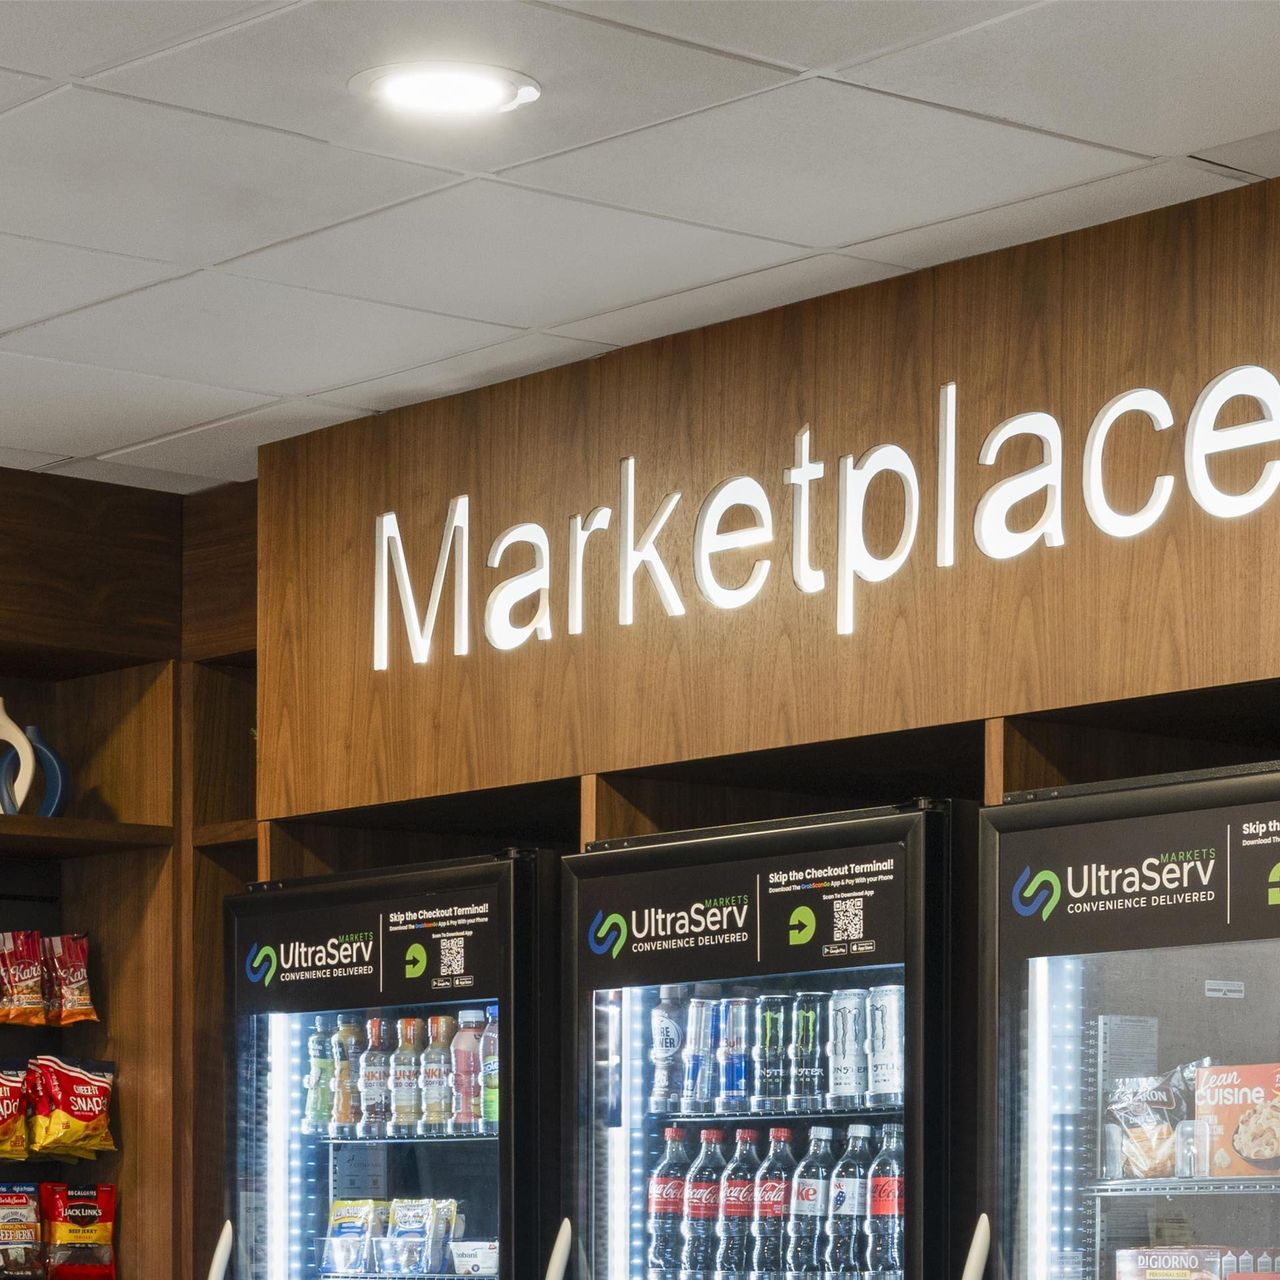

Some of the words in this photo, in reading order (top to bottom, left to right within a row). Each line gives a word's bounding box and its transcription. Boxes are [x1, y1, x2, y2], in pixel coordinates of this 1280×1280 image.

[1242, 821, 1267, 836] Skip
[1242, 837, 1271, 847] Download
[1160, 848, 1216, 863] MARKETS
[769, 871, 788, 885] Skip
[789, 869, 804, 880] the
[805, 865, 849, 879] Checkout
[849, 858, 894, 874] Terminal!
[1067, 857, 1215, 899] UltraServ
[704, 894, 749, 908] MARKETS
[1067, 897, 1147, 914] CONVENIENCE
[1151, 890, 1215, 906] DELIVERED
[389, 912, 405, 924] Skip
[405, 911, 417, 920] the
[418, 907, 453, 919] Checkout
[453, 903, 489, 915] Terminal!
[631, 902, 748, 939] UltraServ
[338, 932, 374, 943] MARKETS
[632, 937, 695, 953] CONVENIENCE
[698, 932, 748, 946] DELIVERED
[280, 938, 373, 969] UltraServ
[280, 968, 331, 982] CONVENIENCE
[333, 965, 373, 978] DELIVERED
[1199, 1070, 1241, 1091] Lean
[15, 1229, 35, 1241] JERKY
